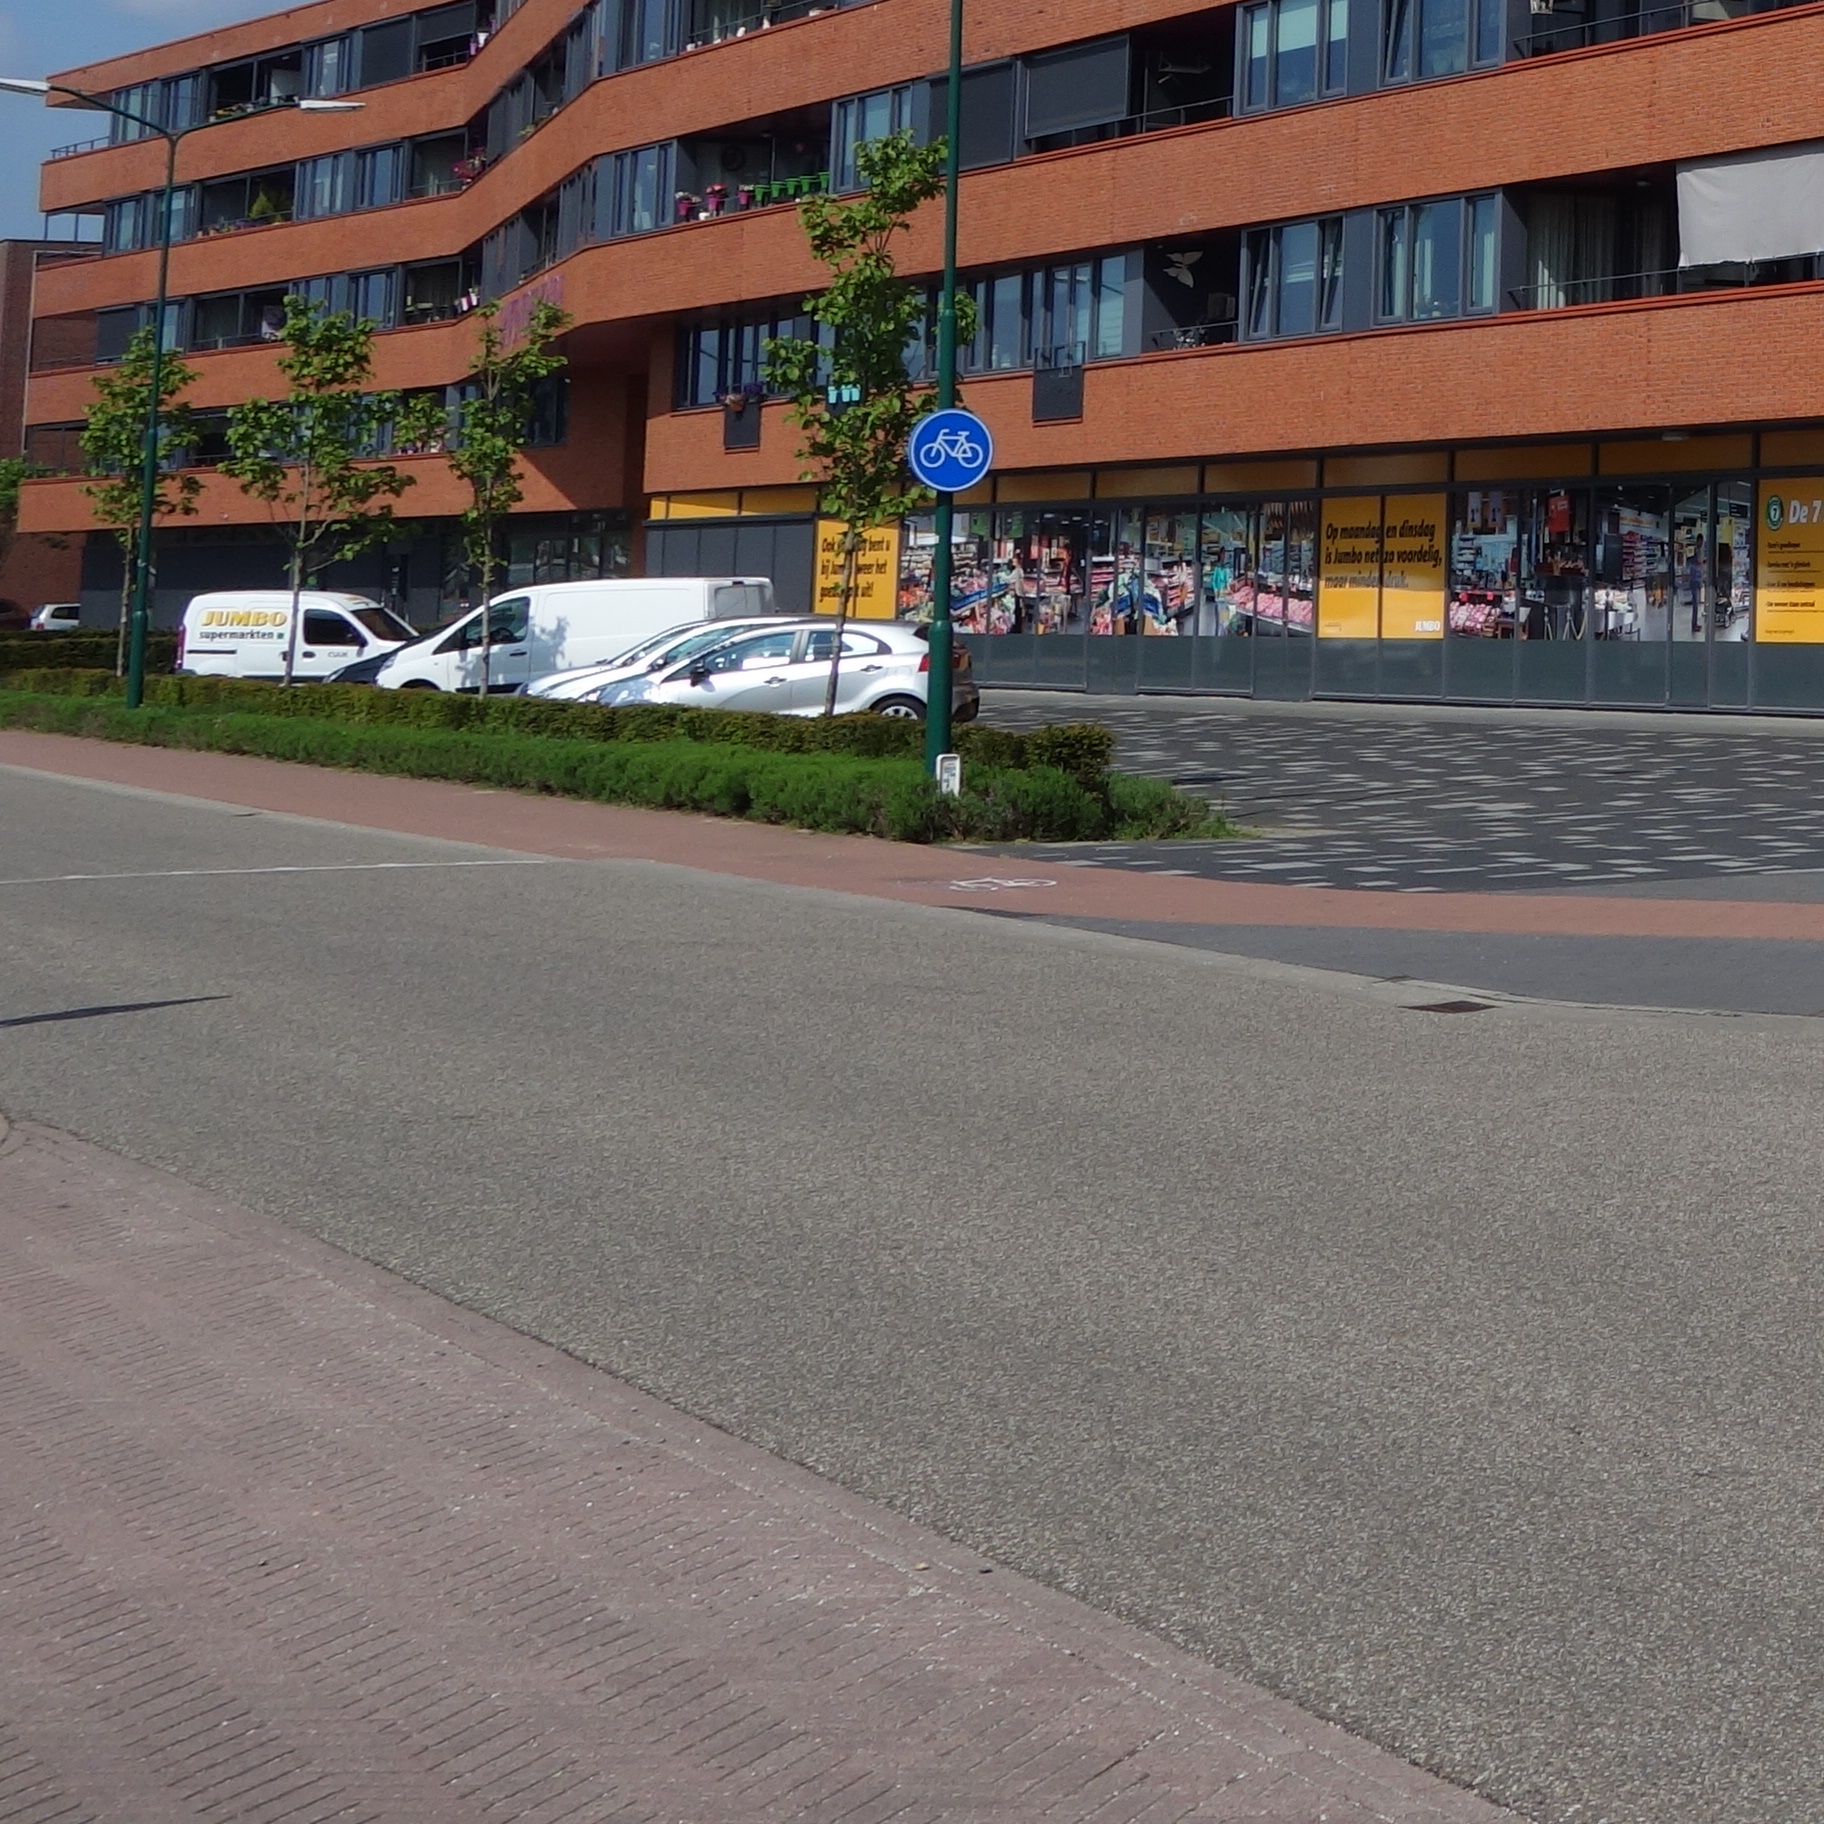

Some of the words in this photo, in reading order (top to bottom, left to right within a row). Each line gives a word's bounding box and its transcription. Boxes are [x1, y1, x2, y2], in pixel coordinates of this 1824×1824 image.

[1788, 499, 1809, 524] De
[1812, 499, 1823, 523] 7
[1326, 522, 1339, 545] Op
[1386, 525, 1398, 539] en
[1400, 519, 1436, 542] dinsdag
[1324, 546, 1333, 565] is
[1333, 546, 1363, 565] Jumbo
[201, 610, 288, 627] JUMBO
[1414, 620, 1441, 632] JUMBO
[199, 629, 274, 641] supermarkten
